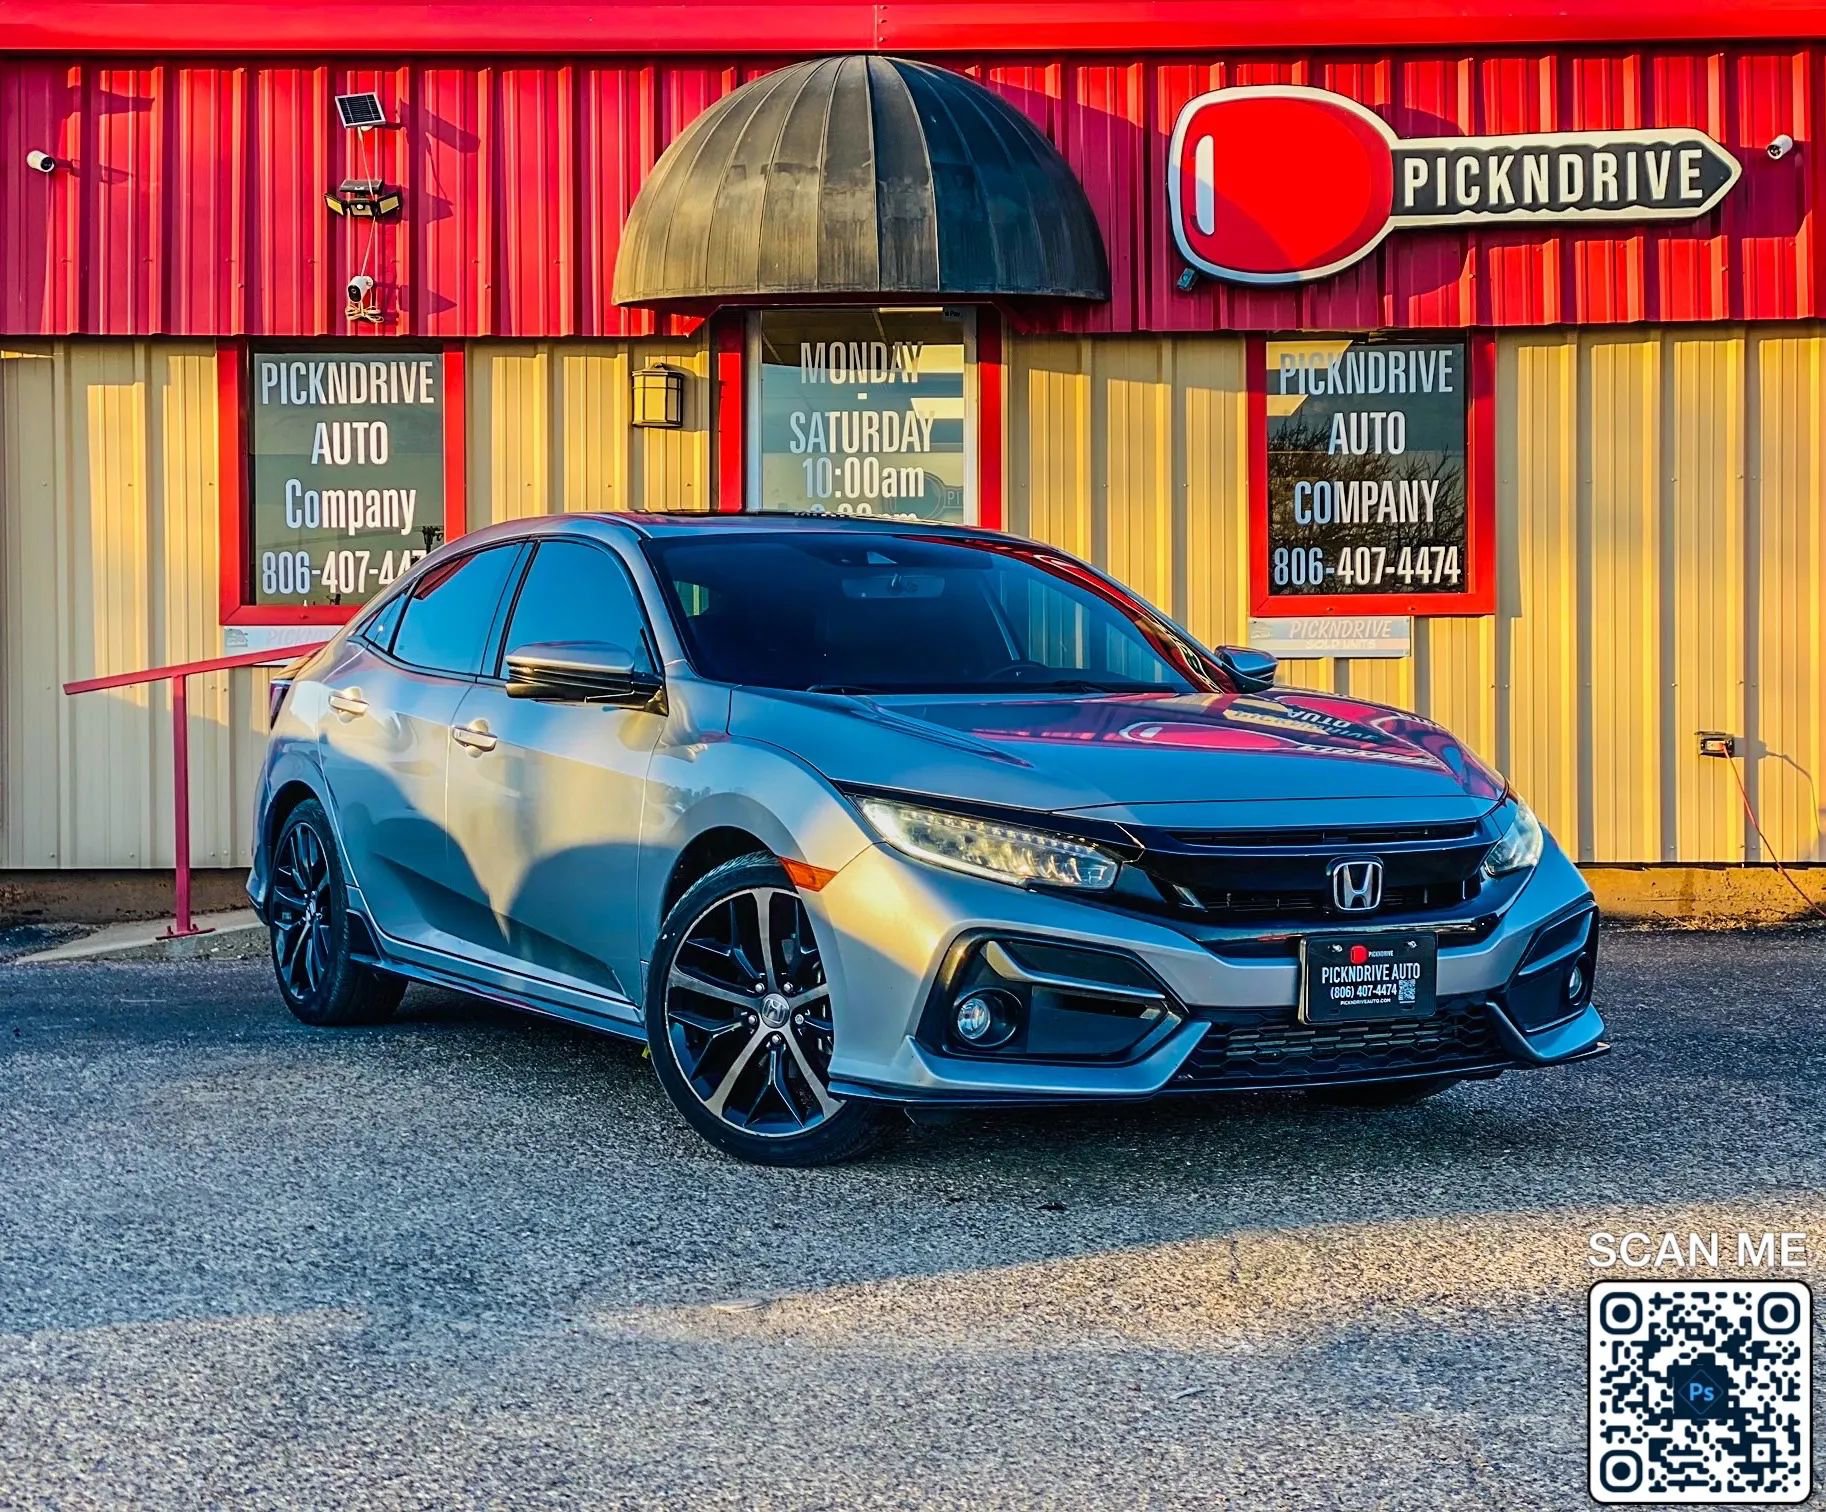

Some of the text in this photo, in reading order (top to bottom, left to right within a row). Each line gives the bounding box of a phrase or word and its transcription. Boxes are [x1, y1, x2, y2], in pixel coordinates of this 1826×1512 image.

[1404, 148, 1704, 208] PICKNDRIVE
[261, 361, 434, 405] PICKNDRIVE
[800, 341, 923, 385] MONDAY
[1279, 350, 1453, 396] PICKNDRIVE
[311, 421, 388, 465] AUTO
[789, 410, 935, 454] SATURDAY
[1328, 411, 1406, 455] AUTO
[802, 456, 925, 499] 10:00am
[285, 478, 416, 536] Company
[1294, 479, 1440, 525] COMPANY
[1274, 546, 1462, 586] 806-407-4474
[1289, 620, 1393, 639] PICKNDRIVE
[1321, 962, 1421, 984] PICKNDRIVE AUTO
[1330, 983, 1398, 1000] (806) 407-4474
